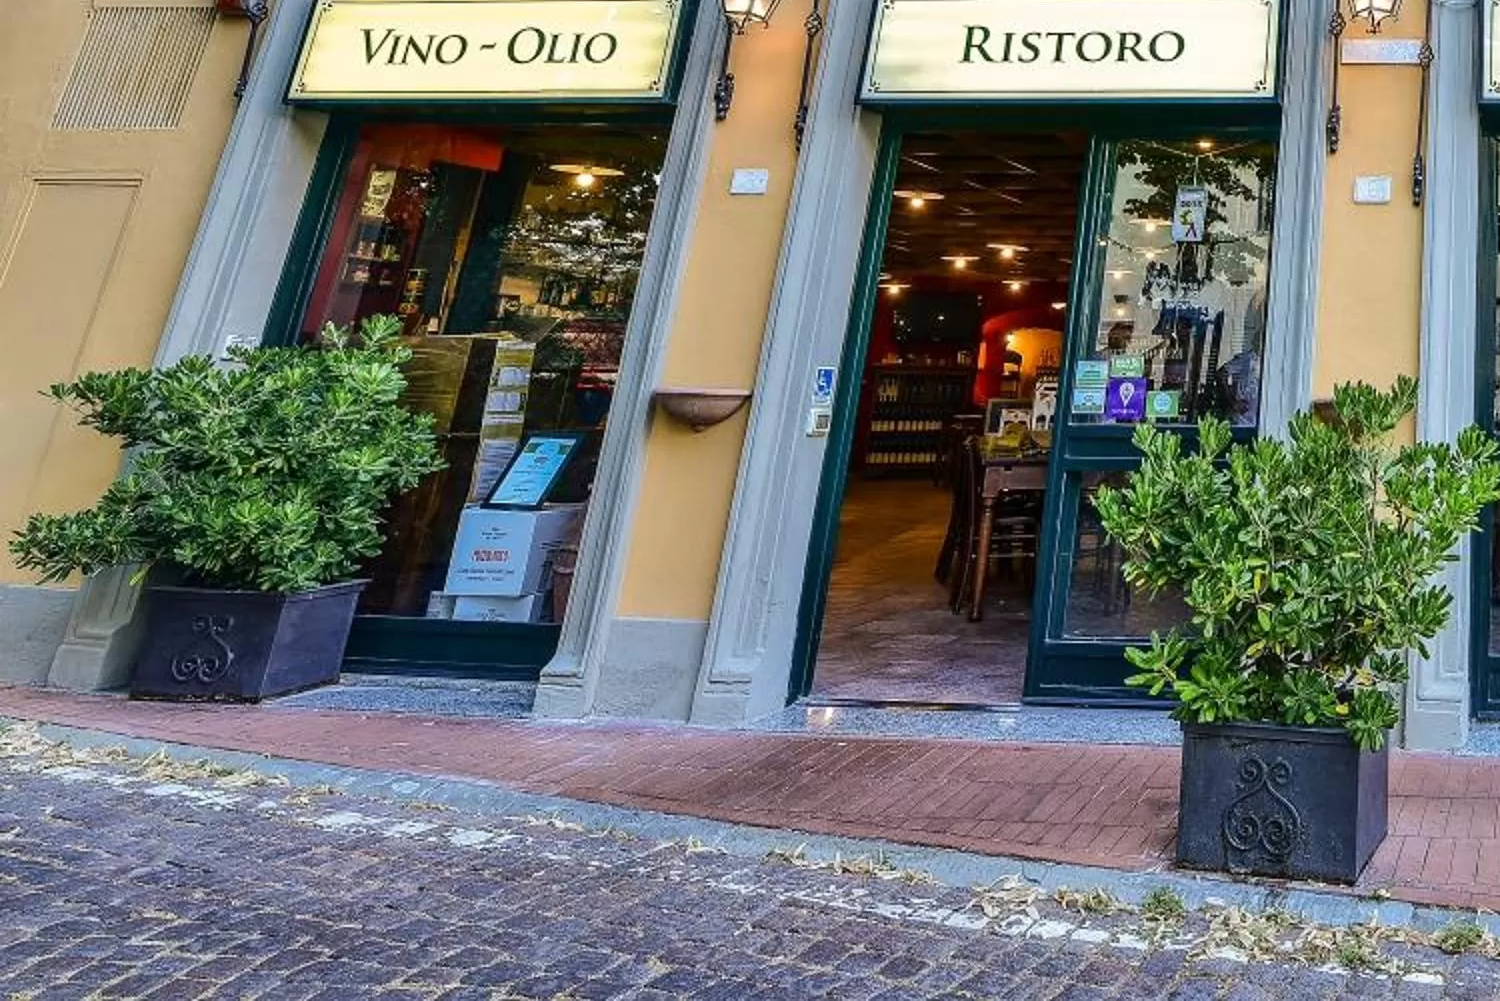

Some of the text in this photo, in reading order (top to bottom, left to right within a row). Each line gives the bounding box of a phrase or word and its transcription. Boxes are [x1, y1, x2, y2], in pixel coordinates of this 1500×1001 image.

[360, 28, 469, 65] VINO
[506, 27, 618, 64] OLIO
[959, 24, 1186, 64] RISTORO
